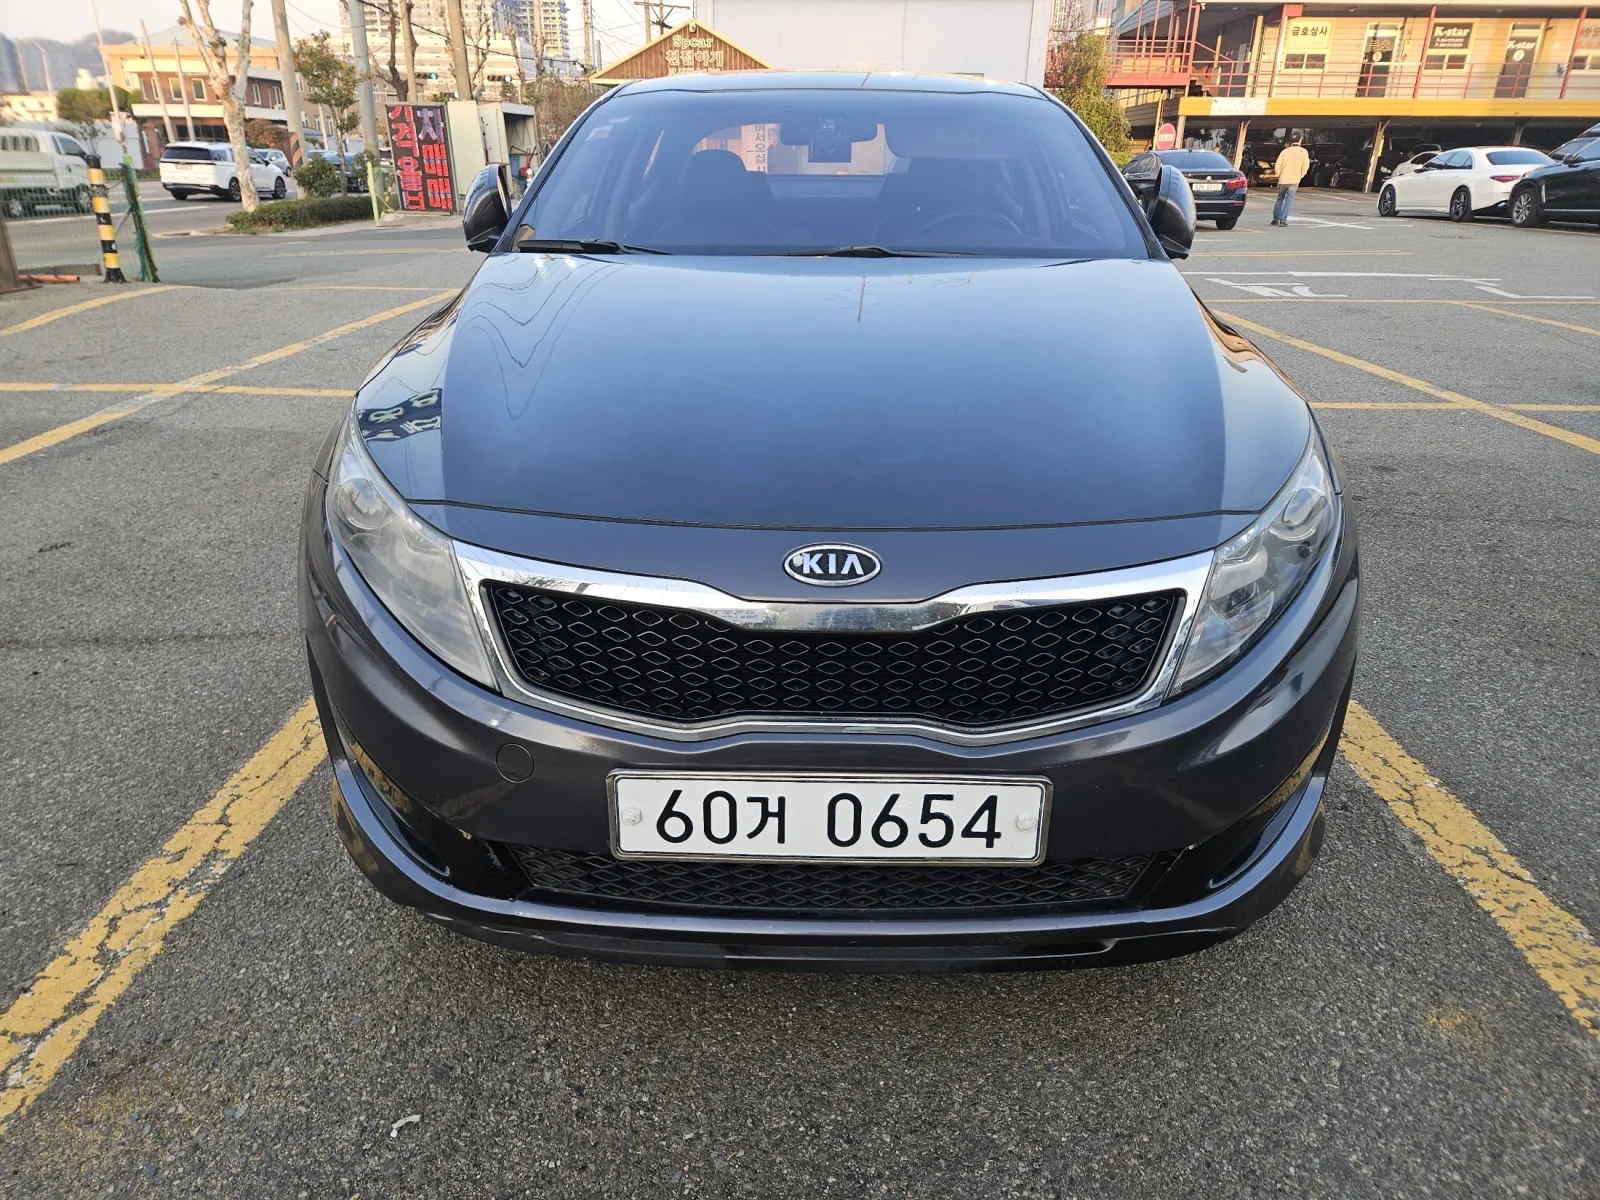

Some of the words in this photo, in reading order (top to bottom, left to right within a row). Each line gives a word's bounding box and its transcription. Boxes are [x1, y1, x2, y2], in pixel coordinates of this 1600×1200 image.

[1292, 26, 1328, 36] 금호상사
[1434, 26, 1470, 36] K-star
[672, 34, 713, 49] Spcar
[1507, 40, 1537, 49] K-star
[665, 49, 724, 67] 친절하게
[802, 553, 864, 575] KIA
[656, 789, 786, 845] 60거
[826, 792, 1002, 849] 0654
